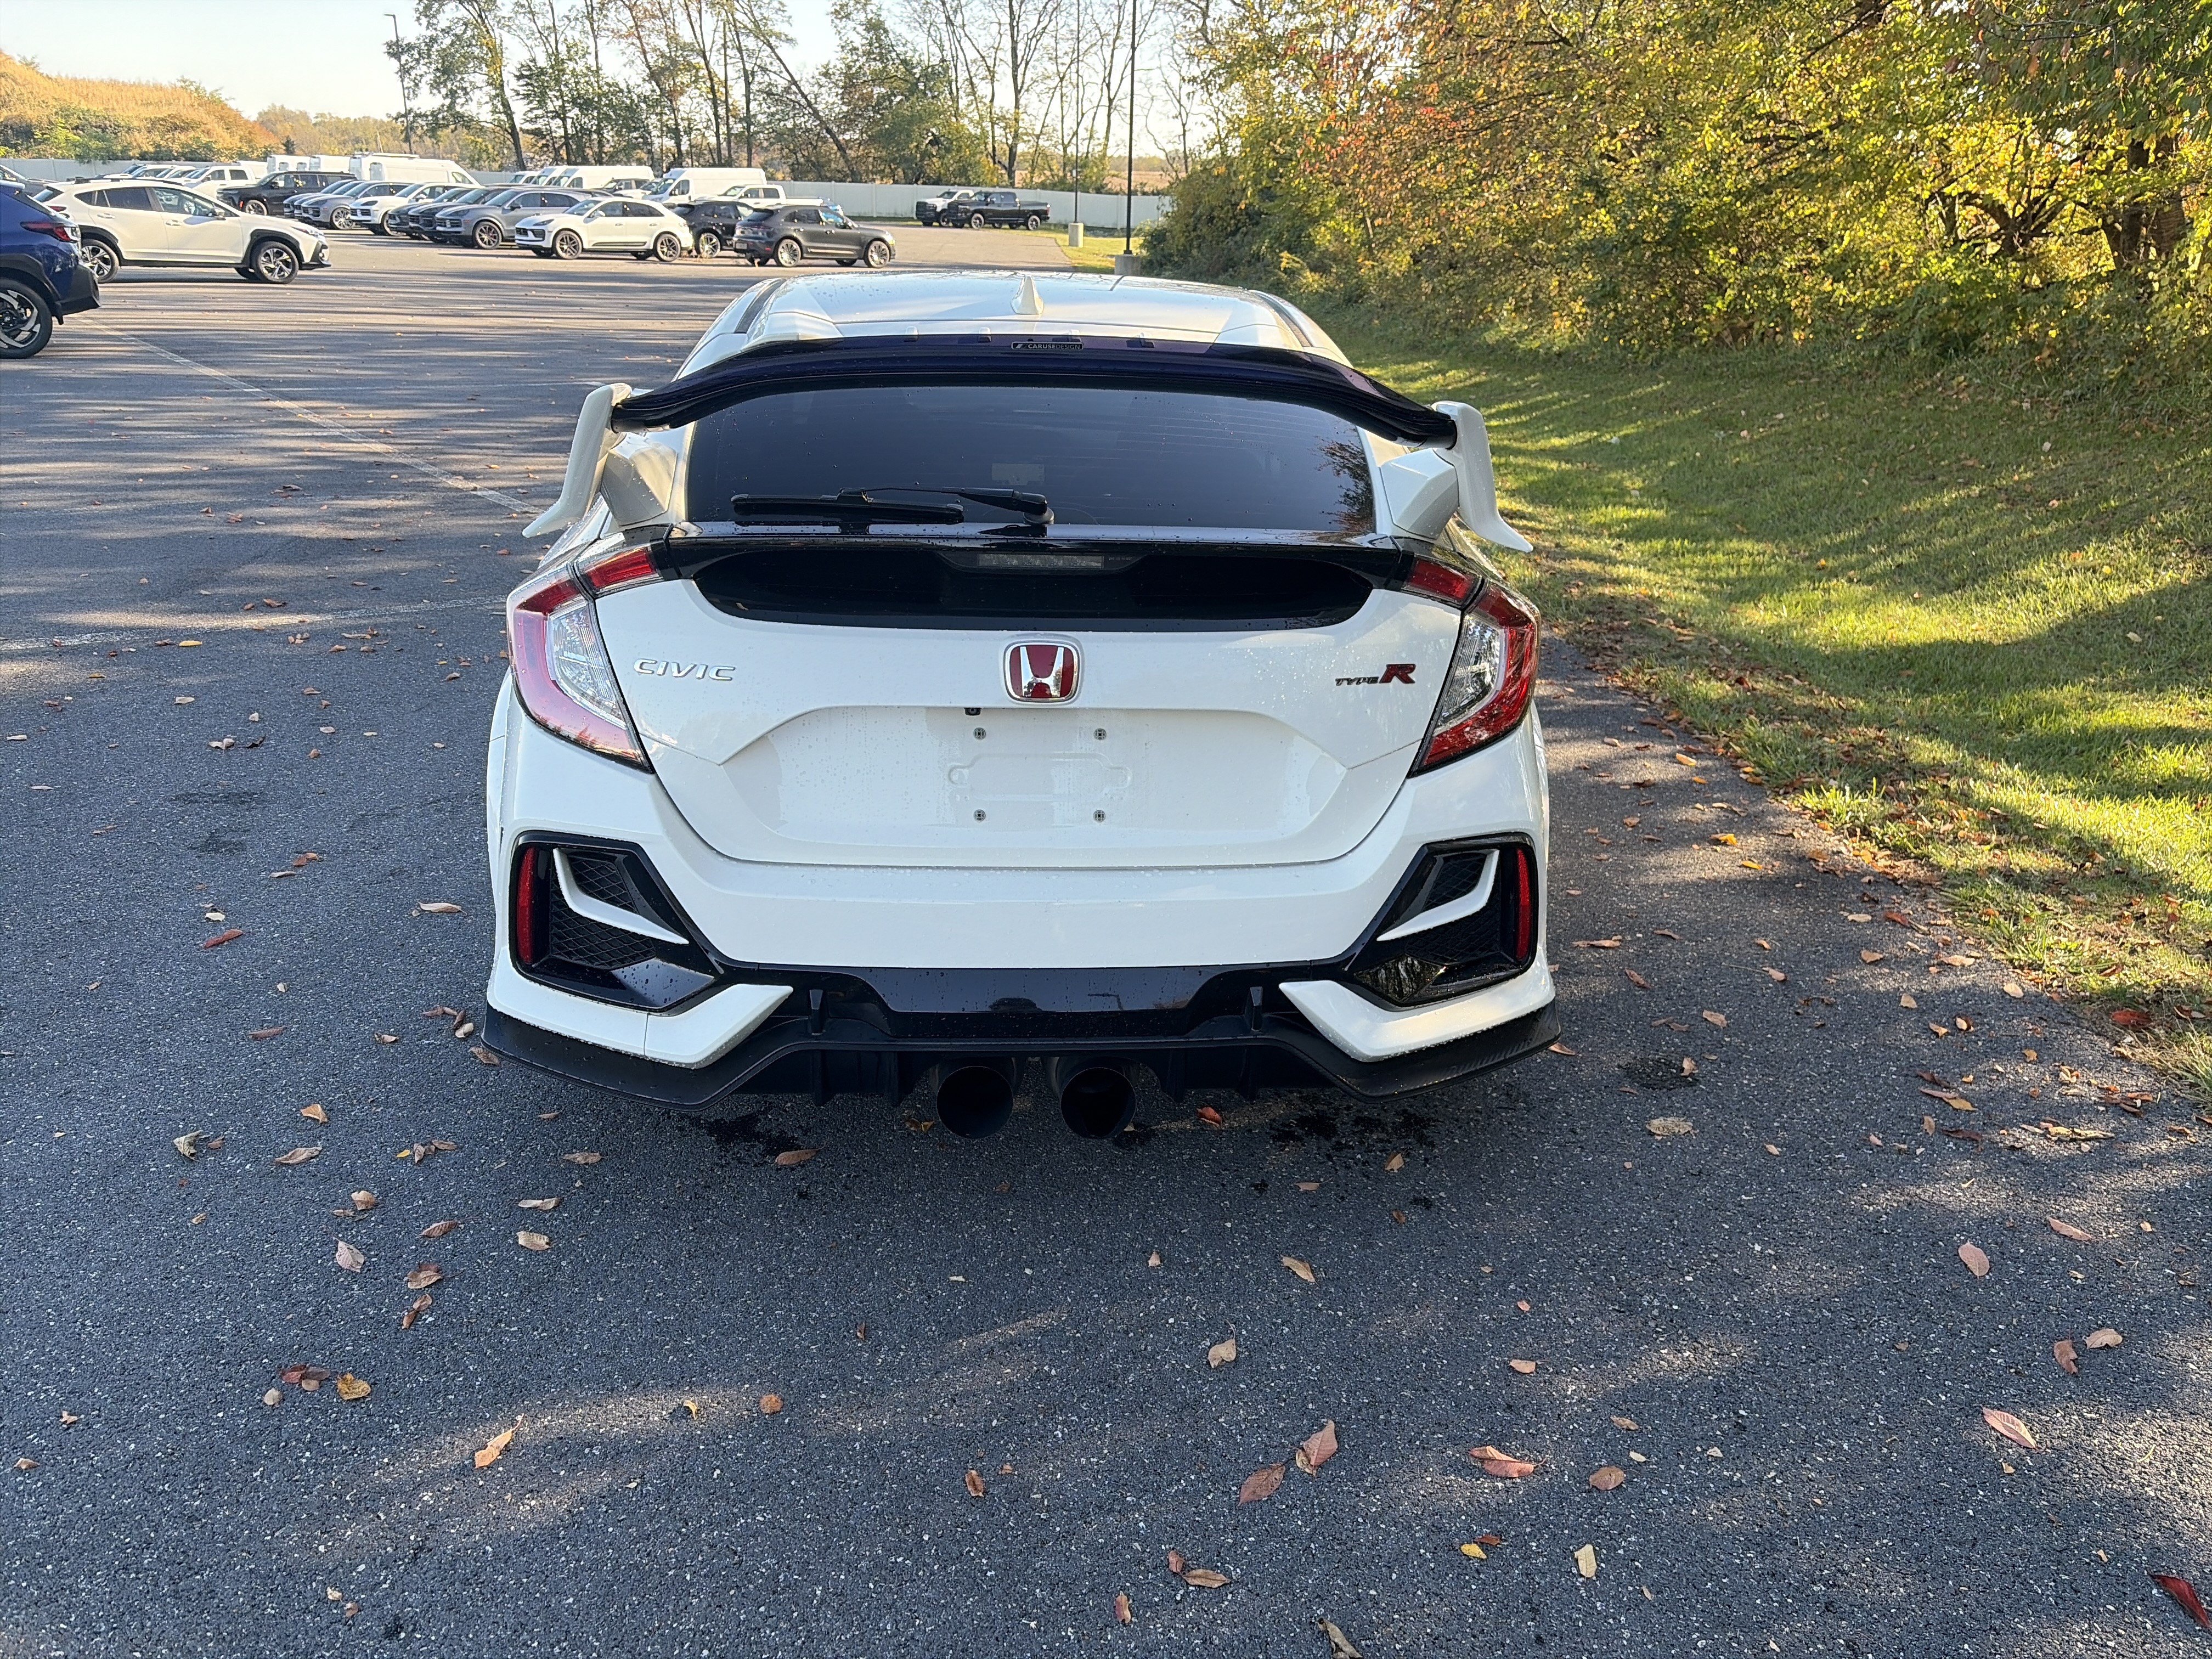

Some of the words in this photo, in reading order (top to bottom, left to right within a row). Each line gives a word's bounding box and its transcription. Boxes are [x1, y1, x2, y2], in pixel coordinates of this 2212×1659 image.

[634, 658, 736, 681] CIVIC
[1335, 676, 1379, 686] TYPE
[1379, 664, 1416, 684] R
